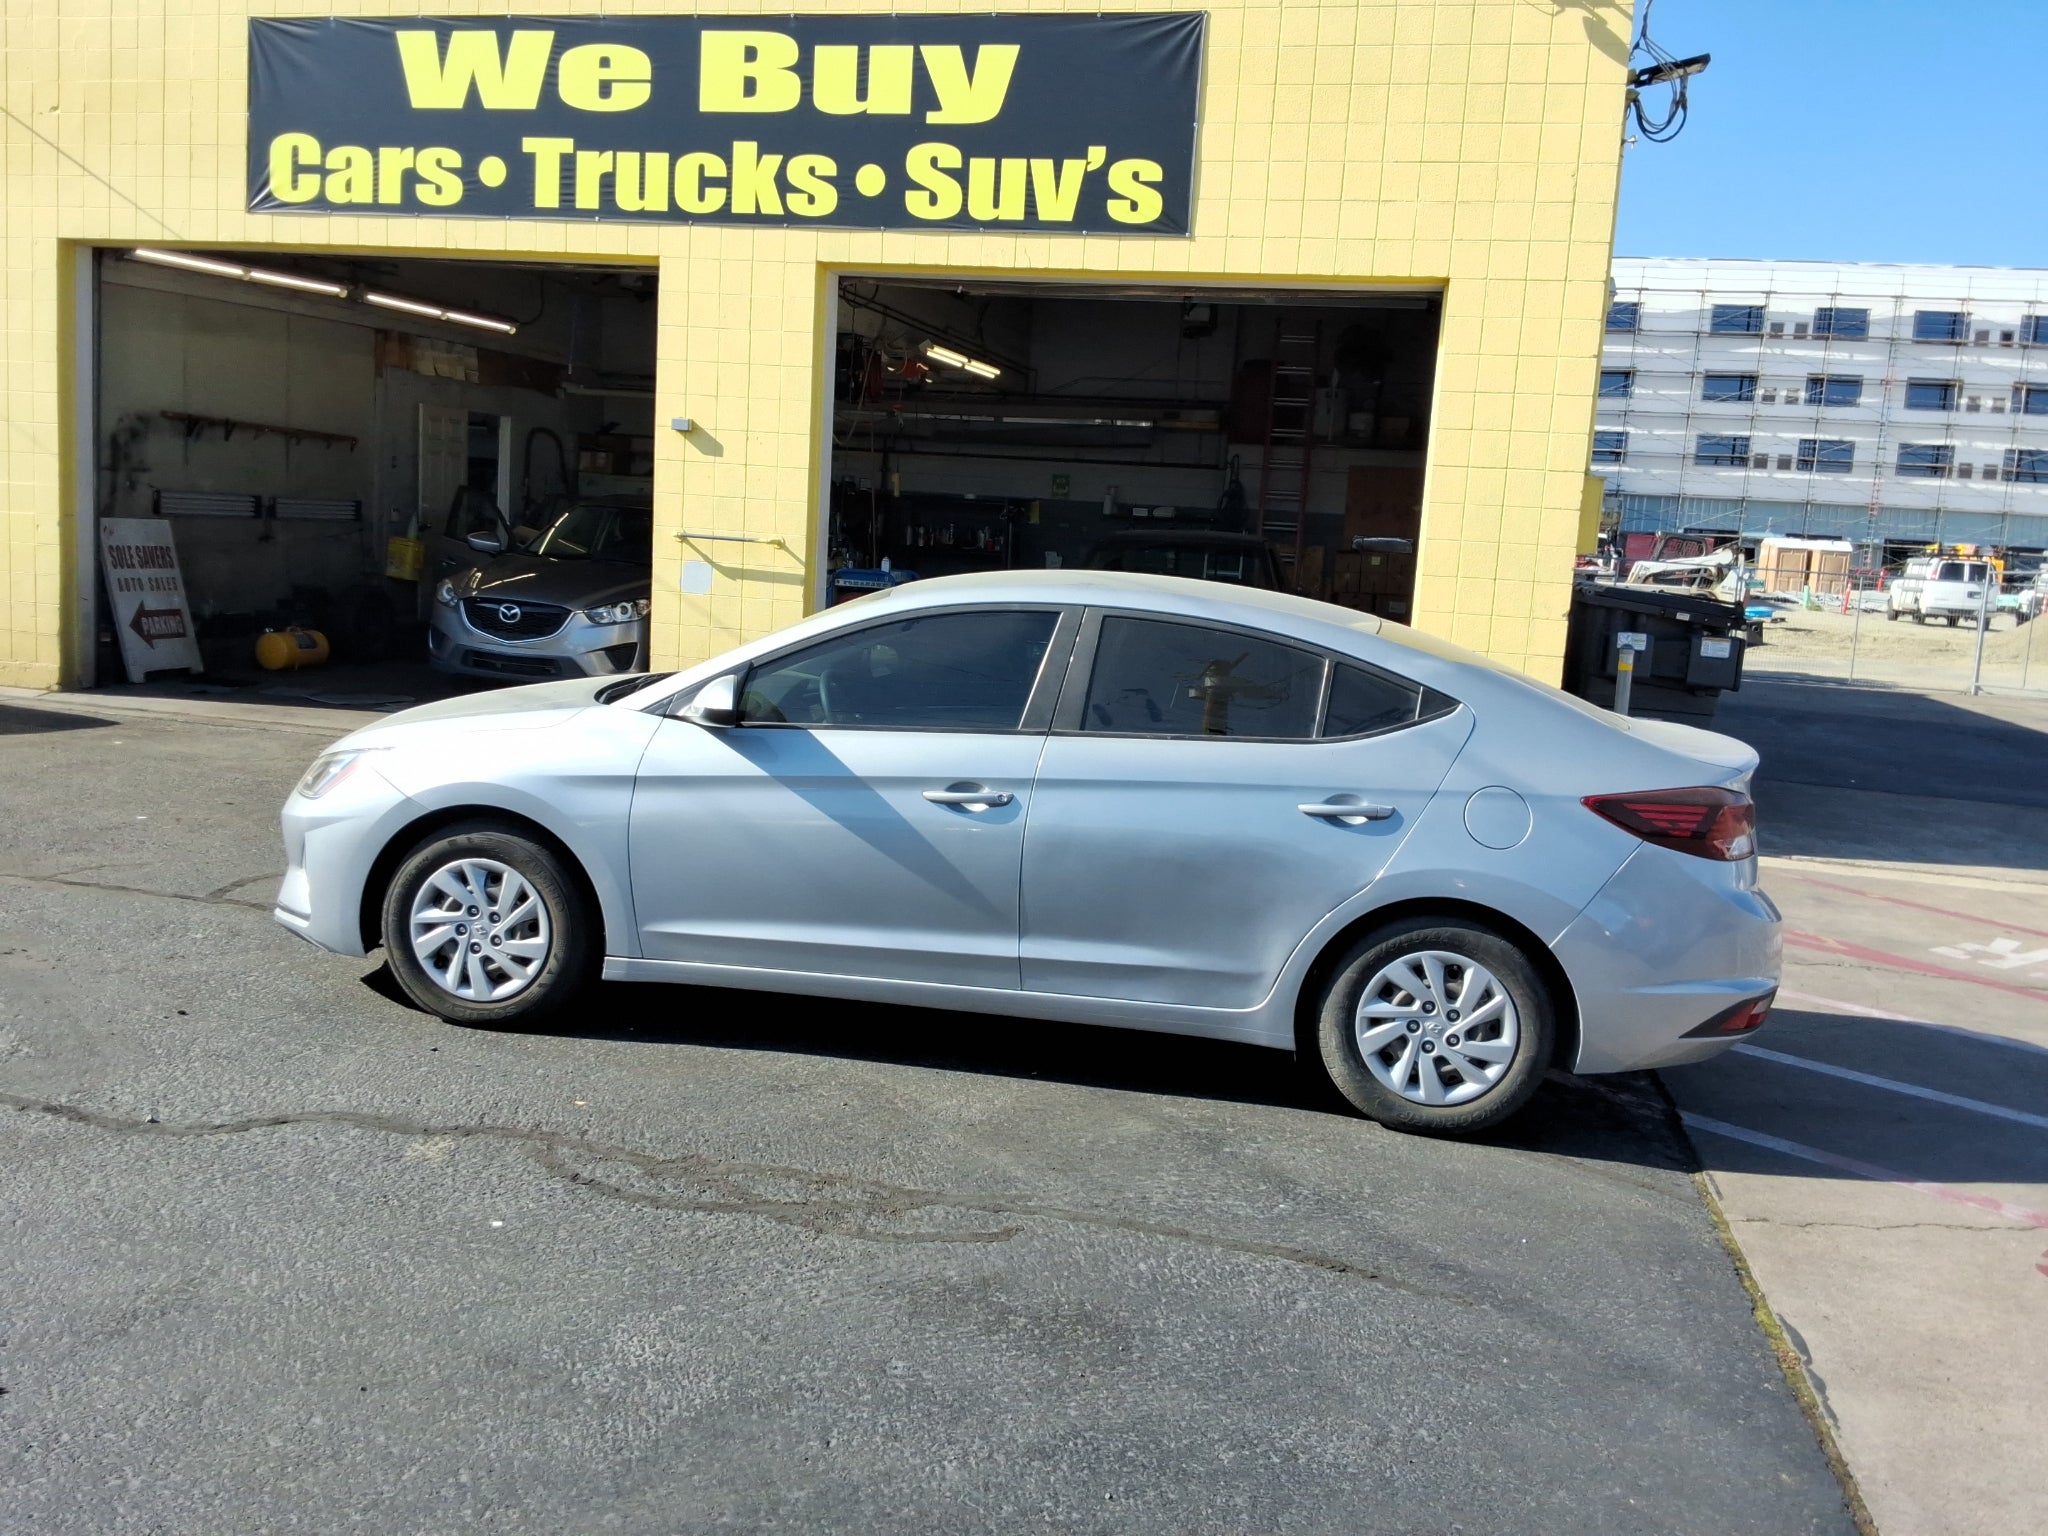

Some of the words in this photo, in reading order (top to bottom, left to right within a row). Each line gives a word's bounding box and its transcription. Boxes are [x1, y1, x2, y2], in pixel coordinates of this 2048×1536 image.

[395, 30, 652, 113] We
[698, 30, 1021, 125] Buy
[267, 132, 464, 207] Cars
[521, 137, 838, 217] Trucks
[904, 142, 1163, 224] Suv's
[108, 544, 137, 570] SOLE
[134, 545, 176, 570] SAVERS
[117, 577, 145, 592] AUTO
[149, 576, 178, 592] SALES
[140, 615, 185, 635] PARKING
